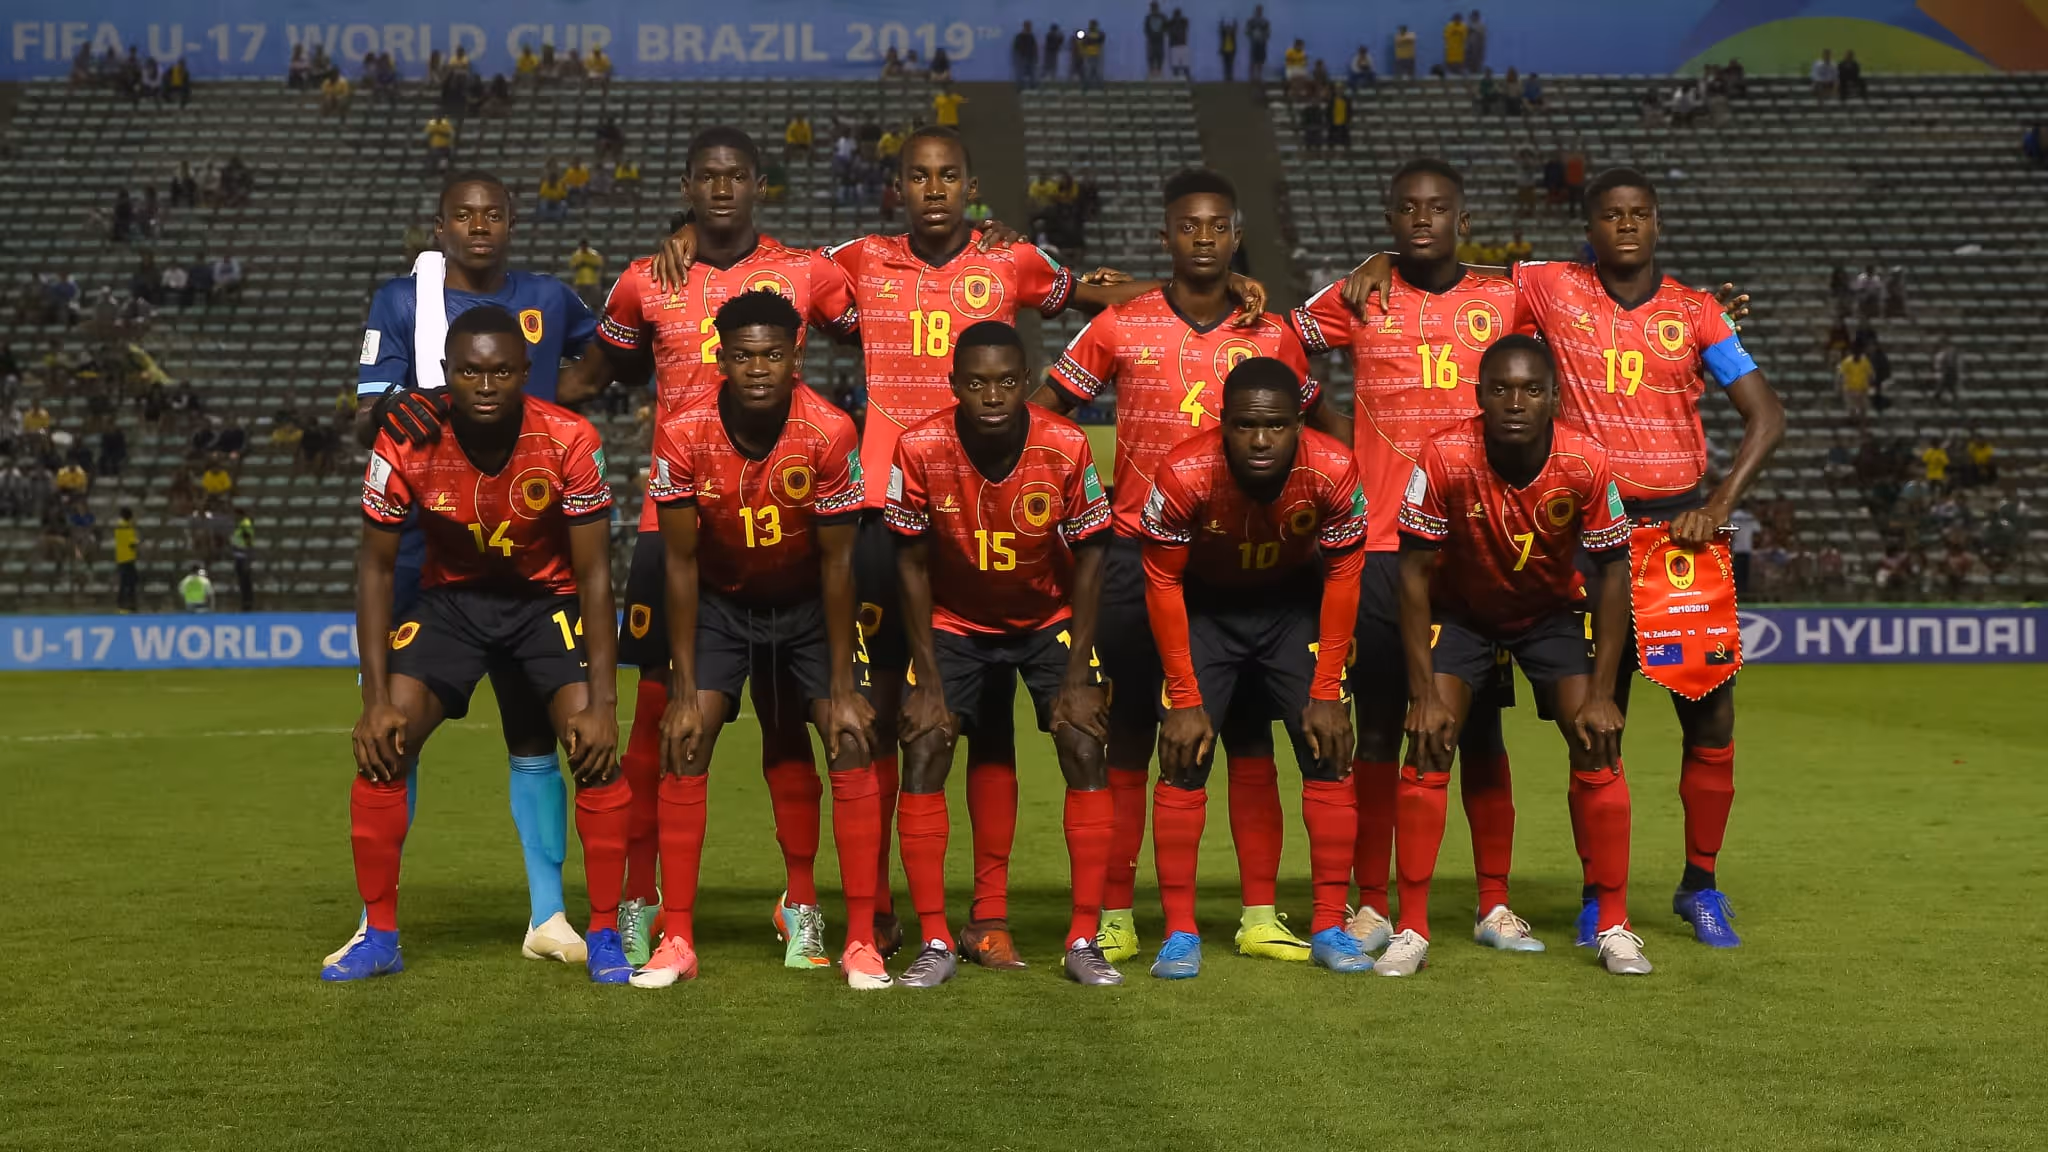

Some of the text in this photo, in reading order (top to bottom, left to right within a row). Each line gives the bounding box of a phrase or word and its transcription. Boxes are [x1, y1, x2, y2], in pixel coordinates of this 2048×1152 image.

[12, 23, 126, 62] FIFA
[148, 23, 266, 64] U-17
[286, 23, 487, 63] WORLD
[637, 23, 829, 63] BRAZIL
[909, 310, 952, 358] 18
[1416, 343, 1459, 390] 16
[1603, 348, 1645, 396] 19
[1179, 380, 1206, 427] 4
[468, 520, 514, 557] 14
[739, 505, 782, 548] 13
[974, 529, 1016, 571] 15
[1238, 541, 1280, 570] 10
[1513, 531, 1535, 572] 7
[13, 626, 116, 663] U-17
[130, 624, 304, 661] WORLD
[1796, 618, 2036, 654] HYUNDAI
